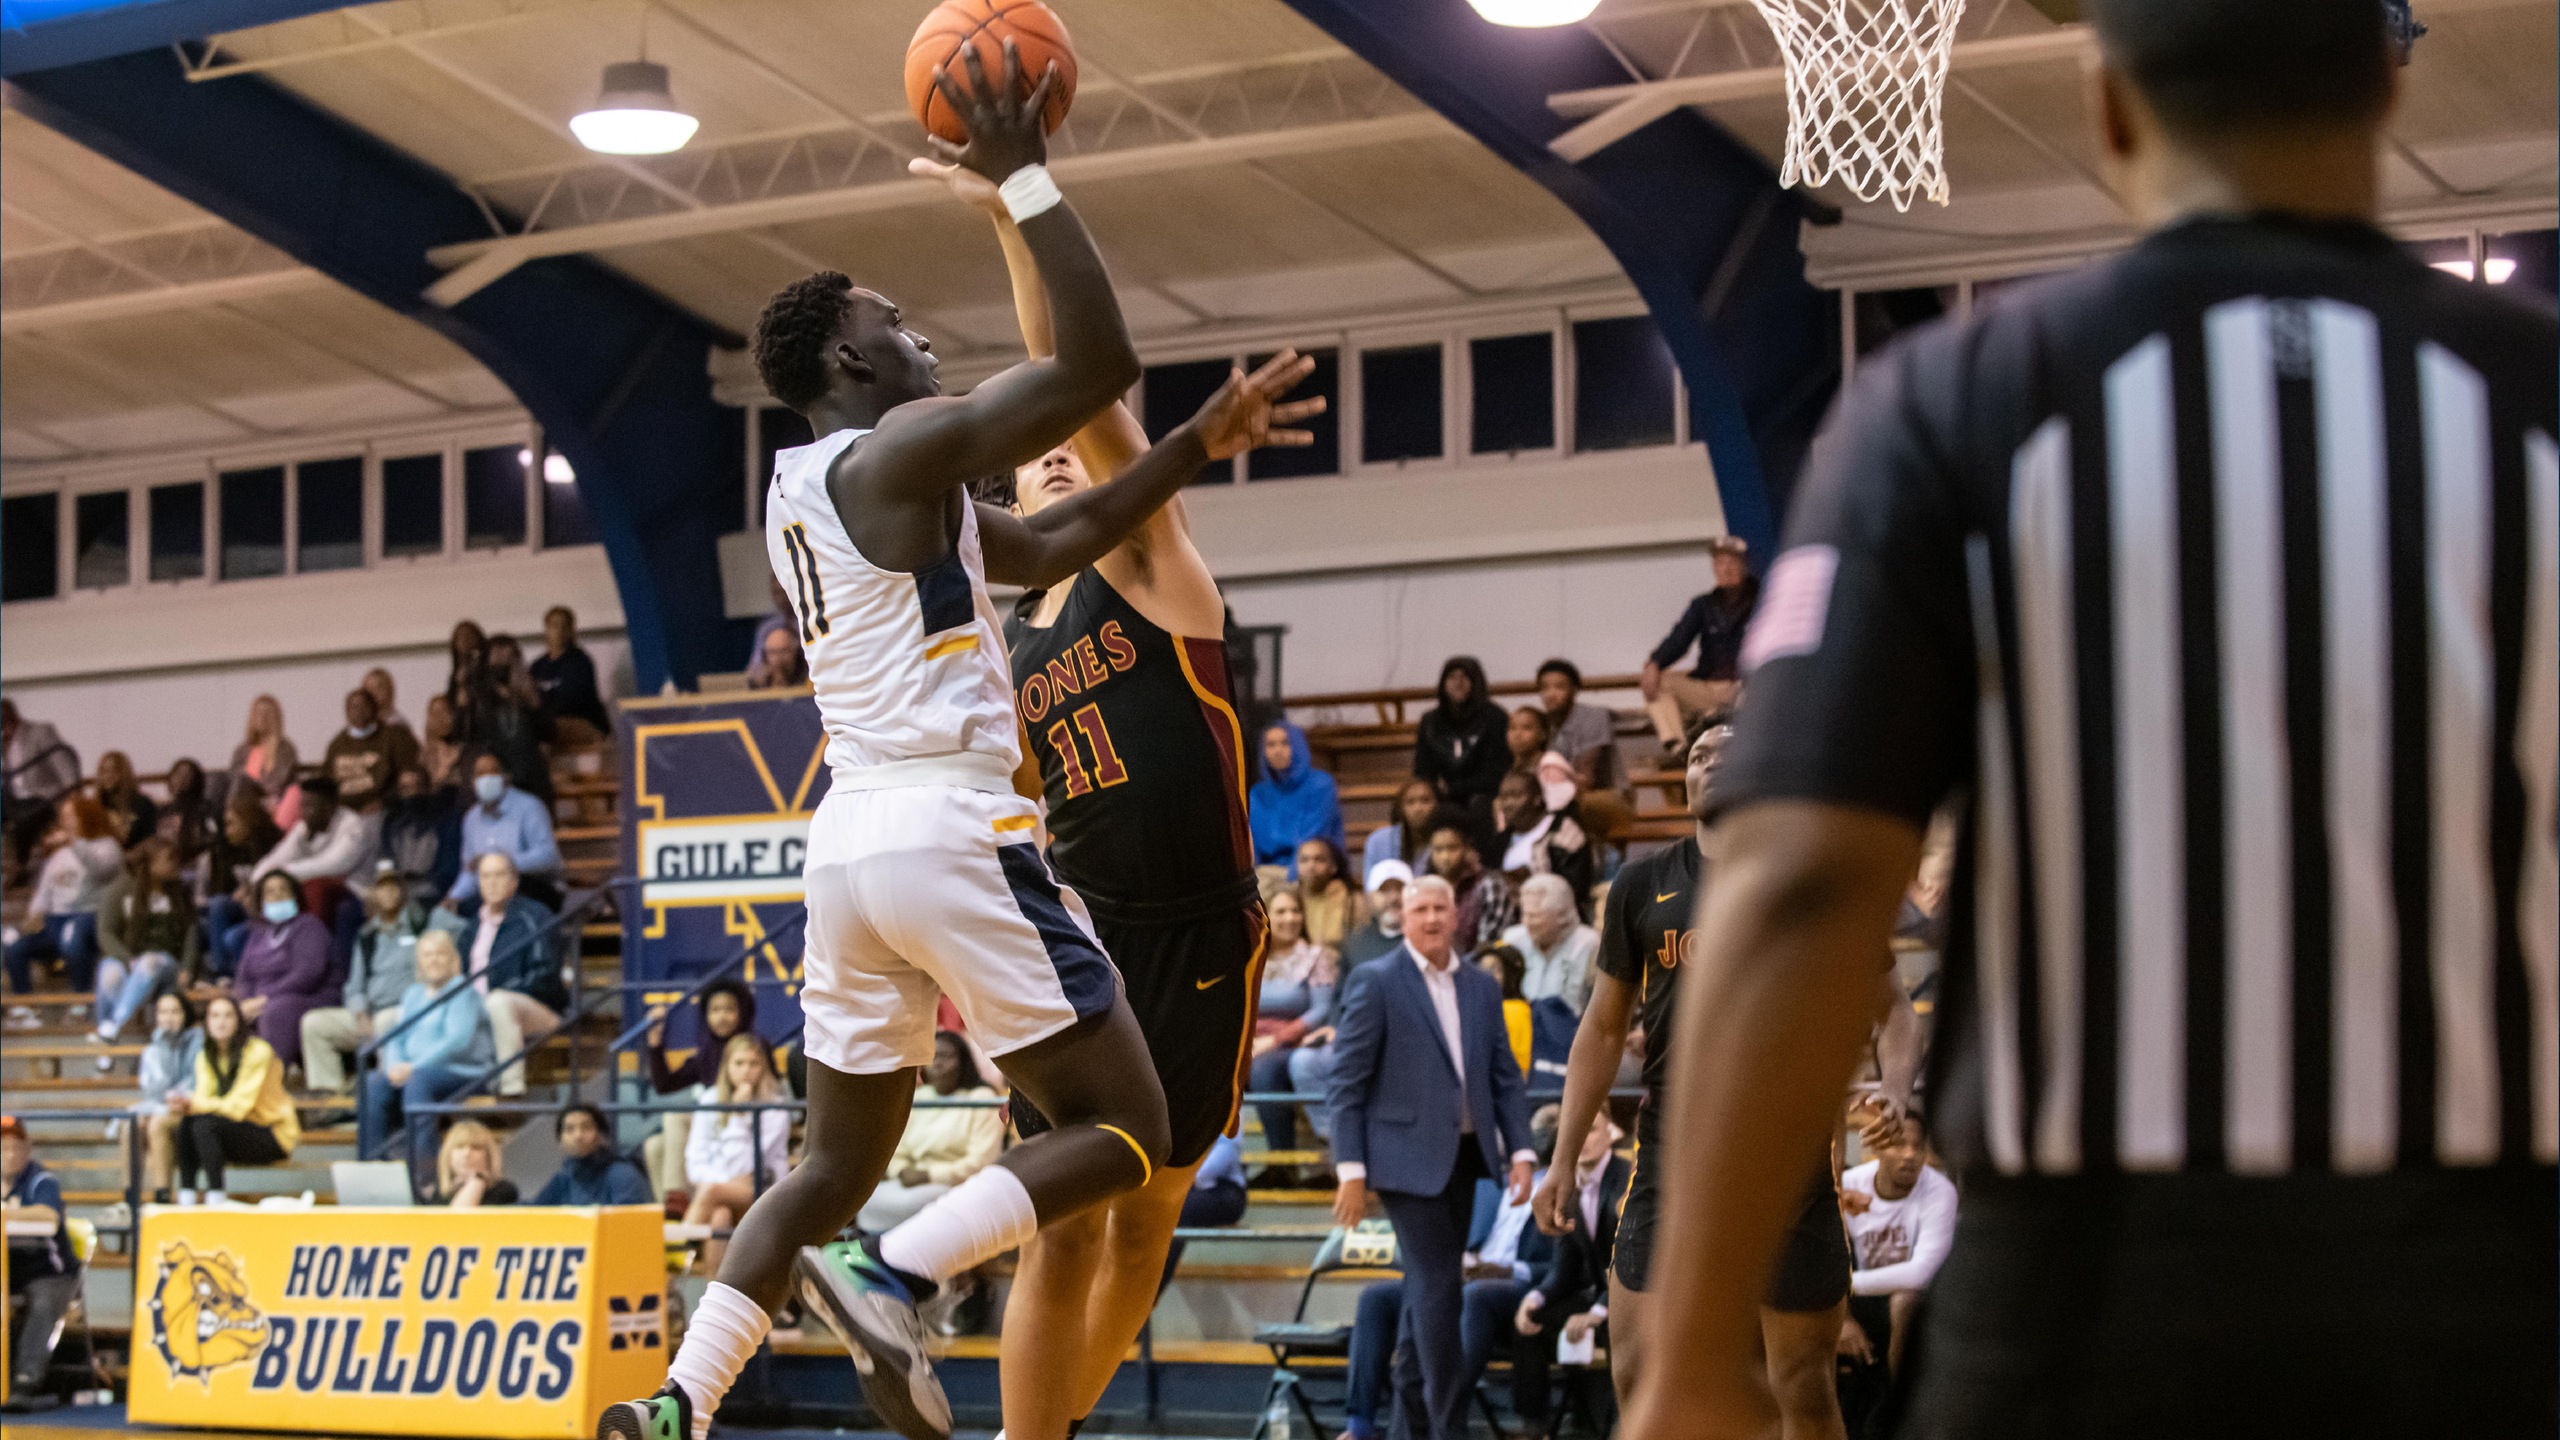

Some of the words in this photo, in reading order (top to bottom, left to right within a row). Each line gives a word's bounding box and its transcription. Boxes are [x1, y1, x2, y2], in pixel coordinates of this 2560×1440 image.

[782, 521, 831, 646] 11
[1047, 701, 1129, 800] 11
[656, 839, 769, 880] GULF
[285, 1245, 411, 1298] HOME
[420, 1246, 480, 1300] OF
[494, 1247, 586, 1300] THE
[252, 1316, 582, 1401] BULLDOGS
